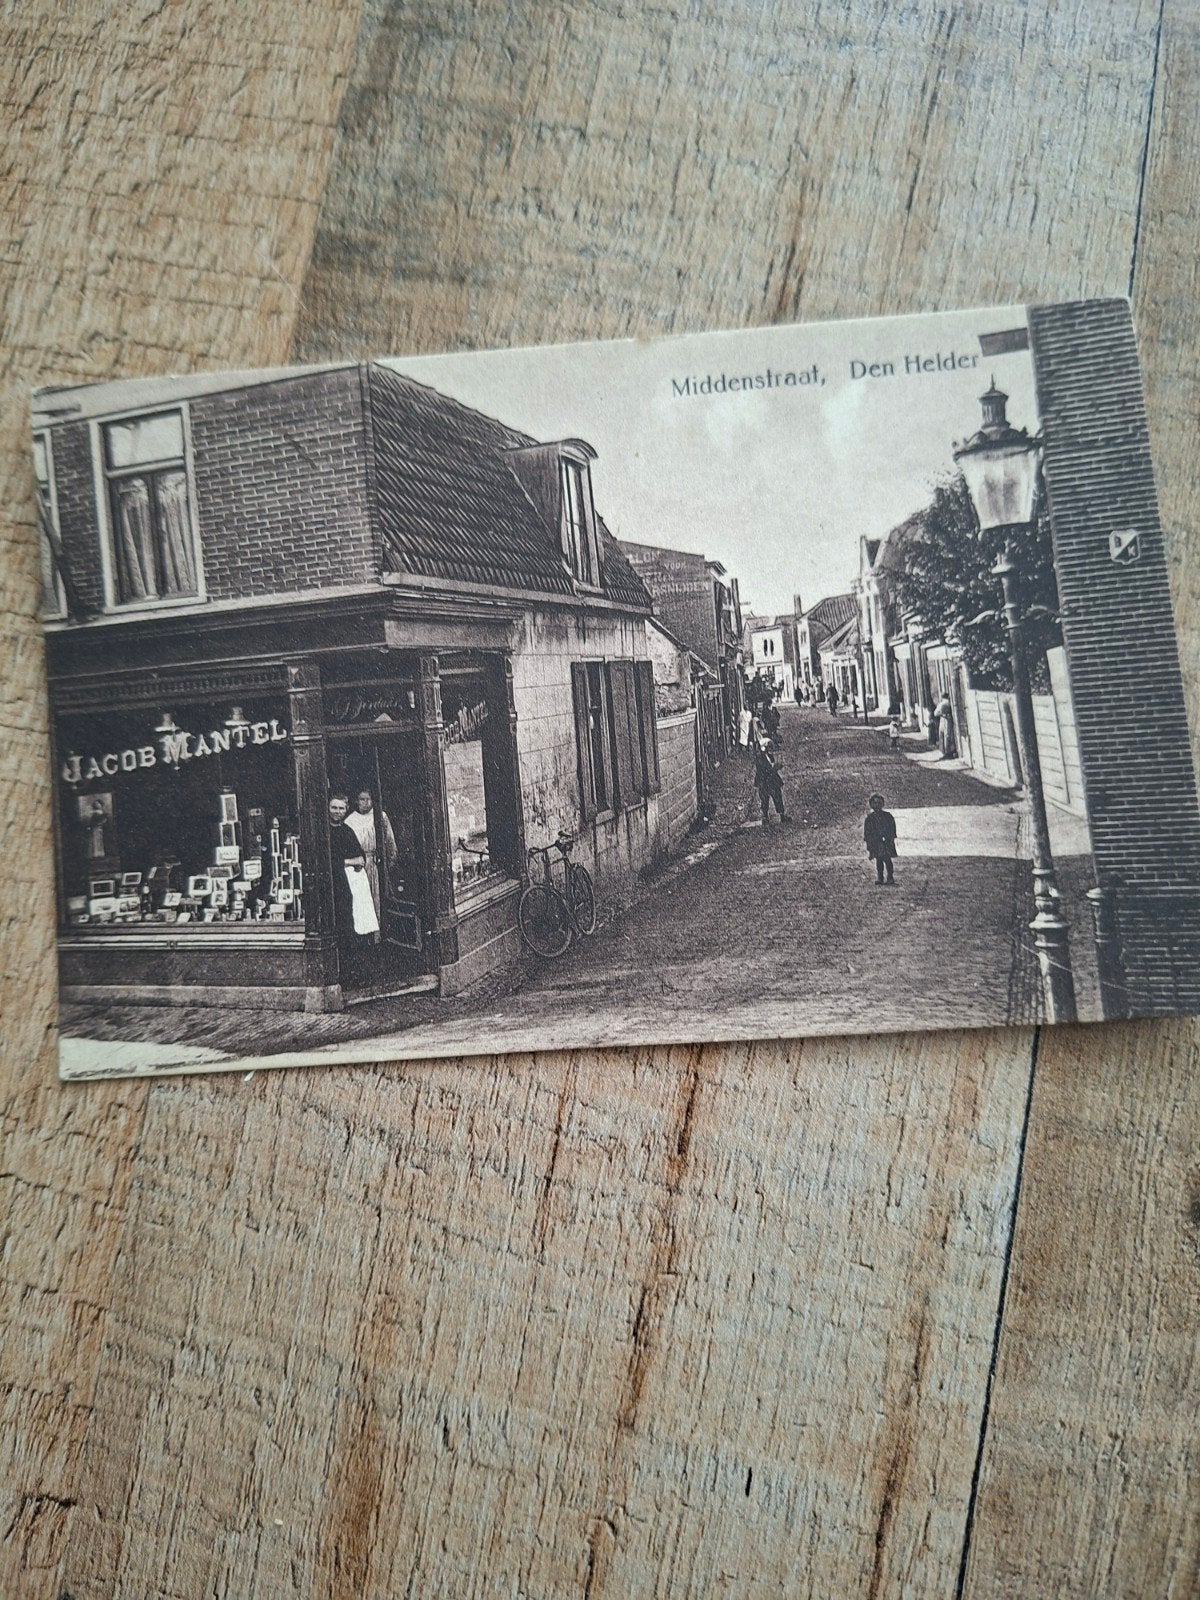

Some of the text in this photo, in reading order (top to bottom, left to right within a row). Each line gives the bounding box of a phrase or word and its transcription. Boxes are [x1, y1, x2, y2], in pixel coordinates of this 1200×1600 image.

[671, 352, 980, 398] Middenstraat, Den Helder
[62, 718, 288, 786] JACOB MANTEL
